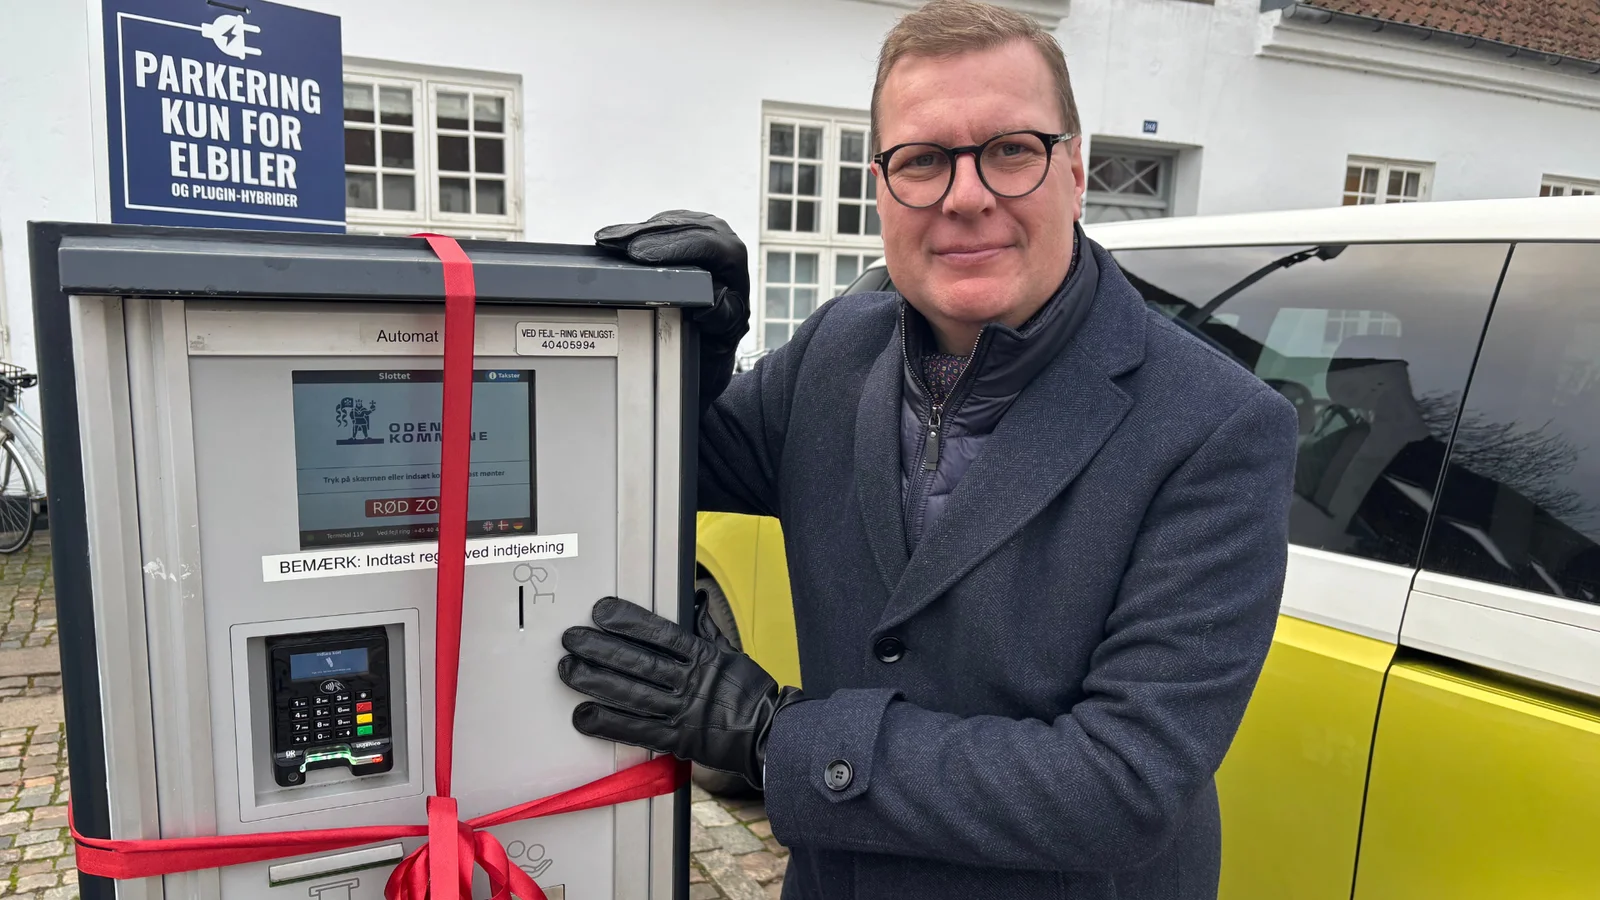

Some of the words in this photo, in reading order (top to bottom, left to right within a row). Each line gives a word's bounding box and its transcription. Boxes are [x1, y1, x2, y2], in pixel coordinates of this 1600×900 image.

[134, 50, 321, 115] PARKERING
[161, 97, 230, 142] KUN
[242, 108, 302, 151] FOR
[170, 140, 298, 189] ELBILER
[172, 182, 189, 198] OG
[193, 186, 298, 208] PLUGIN-HYBRIDER
[376, 329, 439, 343] Automat
[521, 329, 536, 338] VED
[538, 329, 578, 339] FEJL-RING
[579, 330, 616, 340] VENLIGST:
[541, 340, 596, 350] 40405994
[378, 372, 411, 380] Slottet
[389, 422, 442, 433] ODEN
[390, 432, 488, 443] KOMMNE
[323, 476, 340, 484] Tryk
[341, 475, 351, 484] på
[373, 500, 408, 514] RØD
[415, 498, 438, 512] ZO
[279, 556, 361, 574] BEMÆRK:
[366, 552, 416, 566] Indtast
[465, 546, 489, 559] ved
[494, 541, 564, 558] indtjekning
